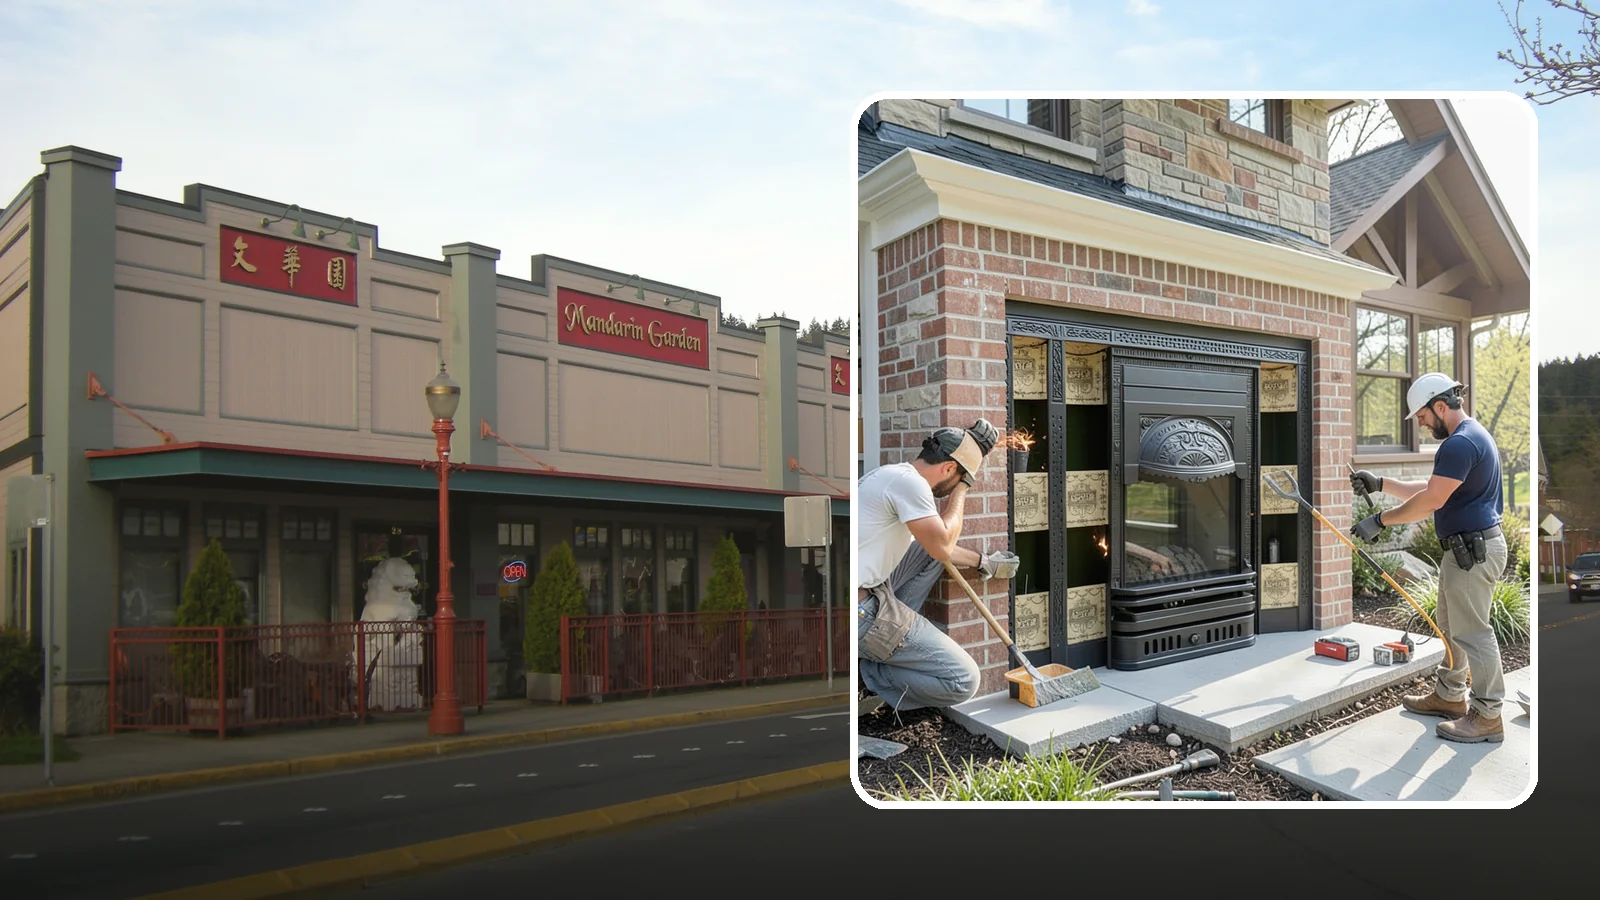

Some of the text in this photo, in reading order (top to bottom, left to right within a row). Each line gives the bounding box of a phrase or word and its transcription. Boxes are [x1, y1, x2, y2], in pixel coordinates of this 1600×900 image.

[231, 235, 346, 290] 文華園
[564, 302, 701, 352] Mandarin Garden
[503, 565, 527, 578] OPEN
